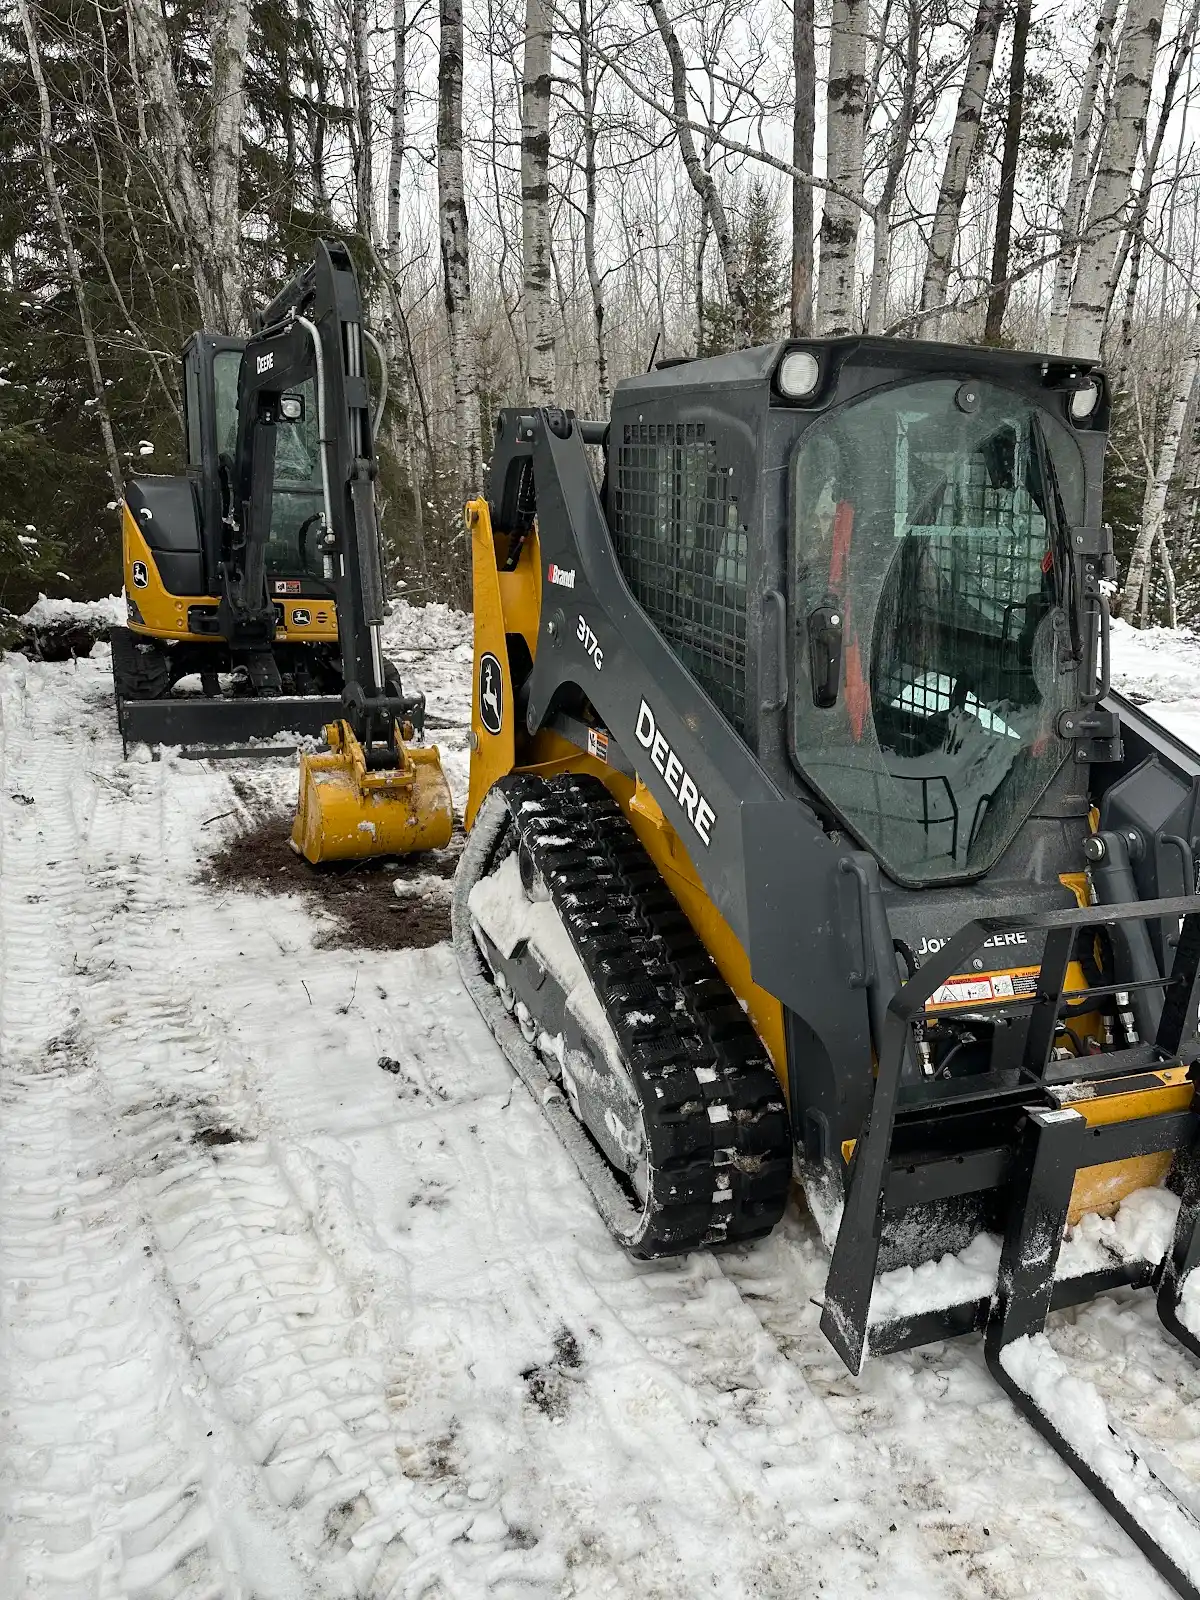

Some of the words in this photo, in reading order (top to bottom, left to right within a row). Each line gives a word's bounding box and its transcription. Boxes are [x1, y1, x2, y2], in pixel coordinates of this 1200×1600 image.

[256, 352, 274, 375] DEERE
[553, 565, 575, 589] Brandt
[576, 614, 603, 671] 317G
[635, 699, 716, 847] DEERE
[983, 932, 1028, 948] EERE
